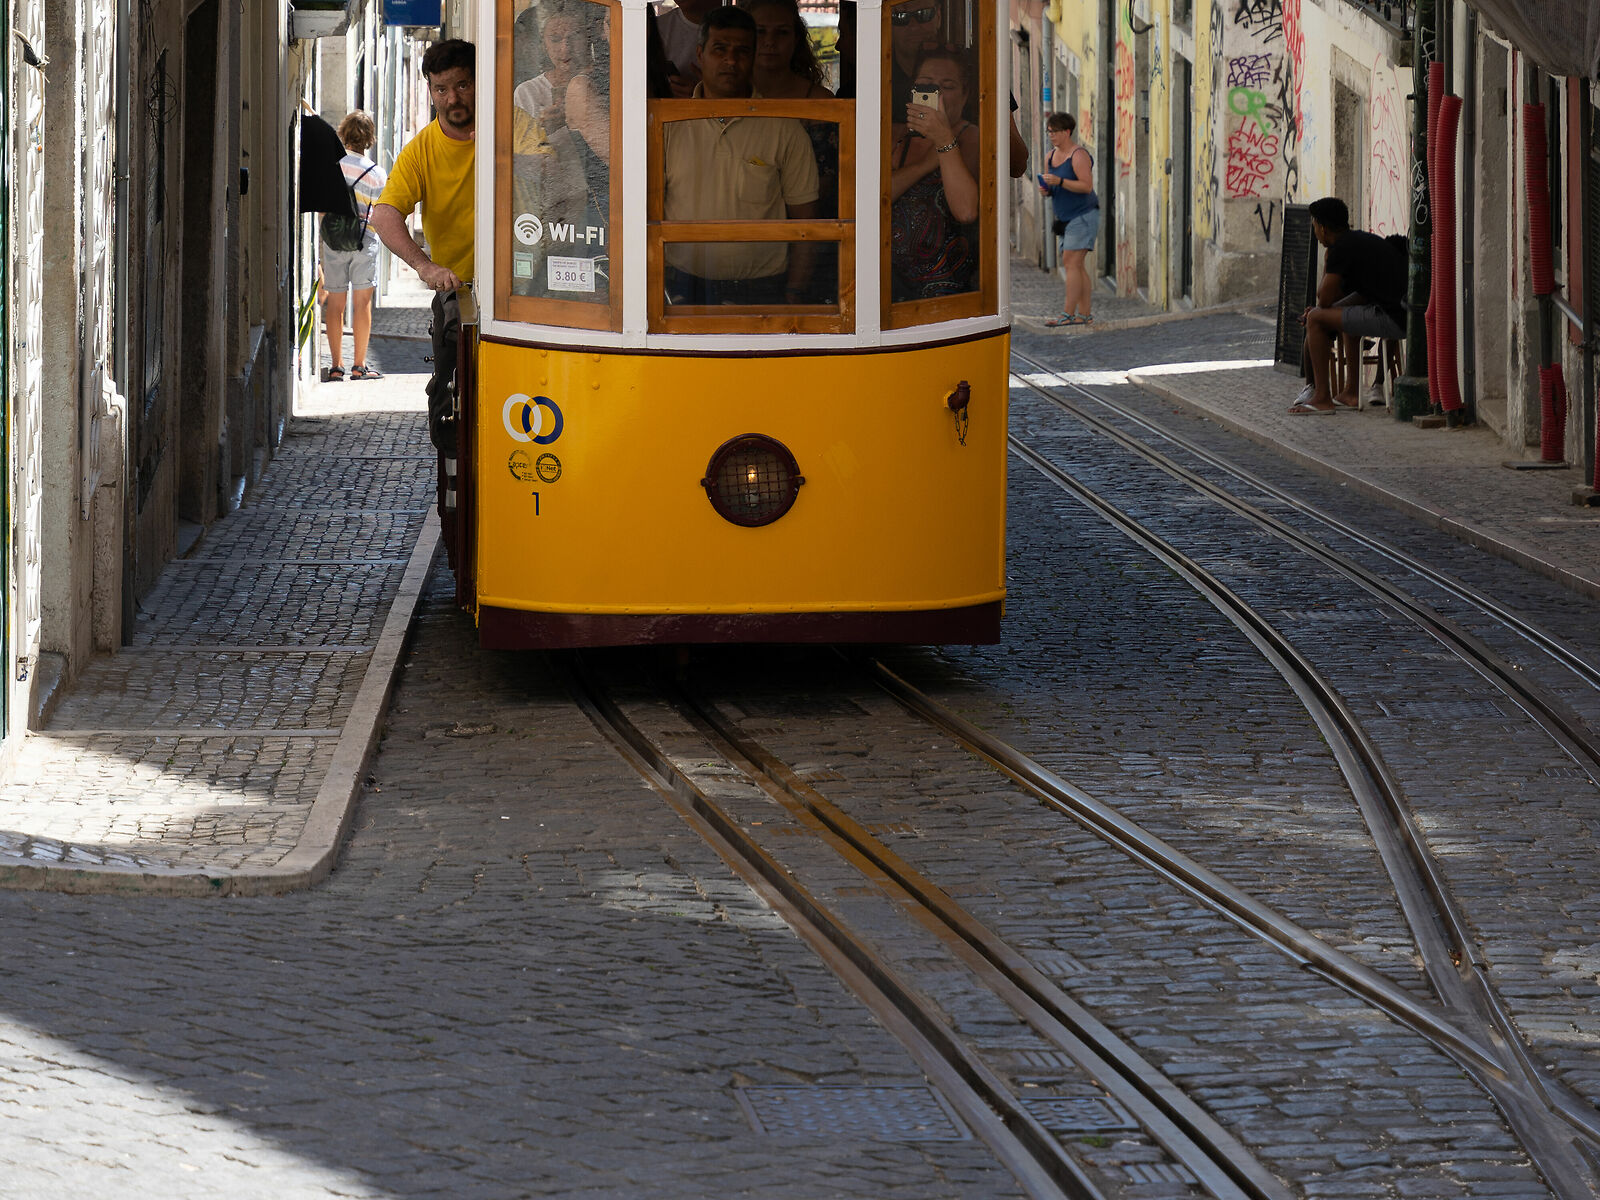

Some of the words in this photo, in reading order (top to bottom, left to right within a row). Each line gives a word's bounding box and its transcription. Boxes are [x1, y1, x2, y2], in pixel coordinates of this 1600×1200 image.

[548, 222, 605, 246] WI-FI
[555, 271, 577, 282] 3.80
[579, 272, 587, 283] €
[531, 491, 540, 516] 1
